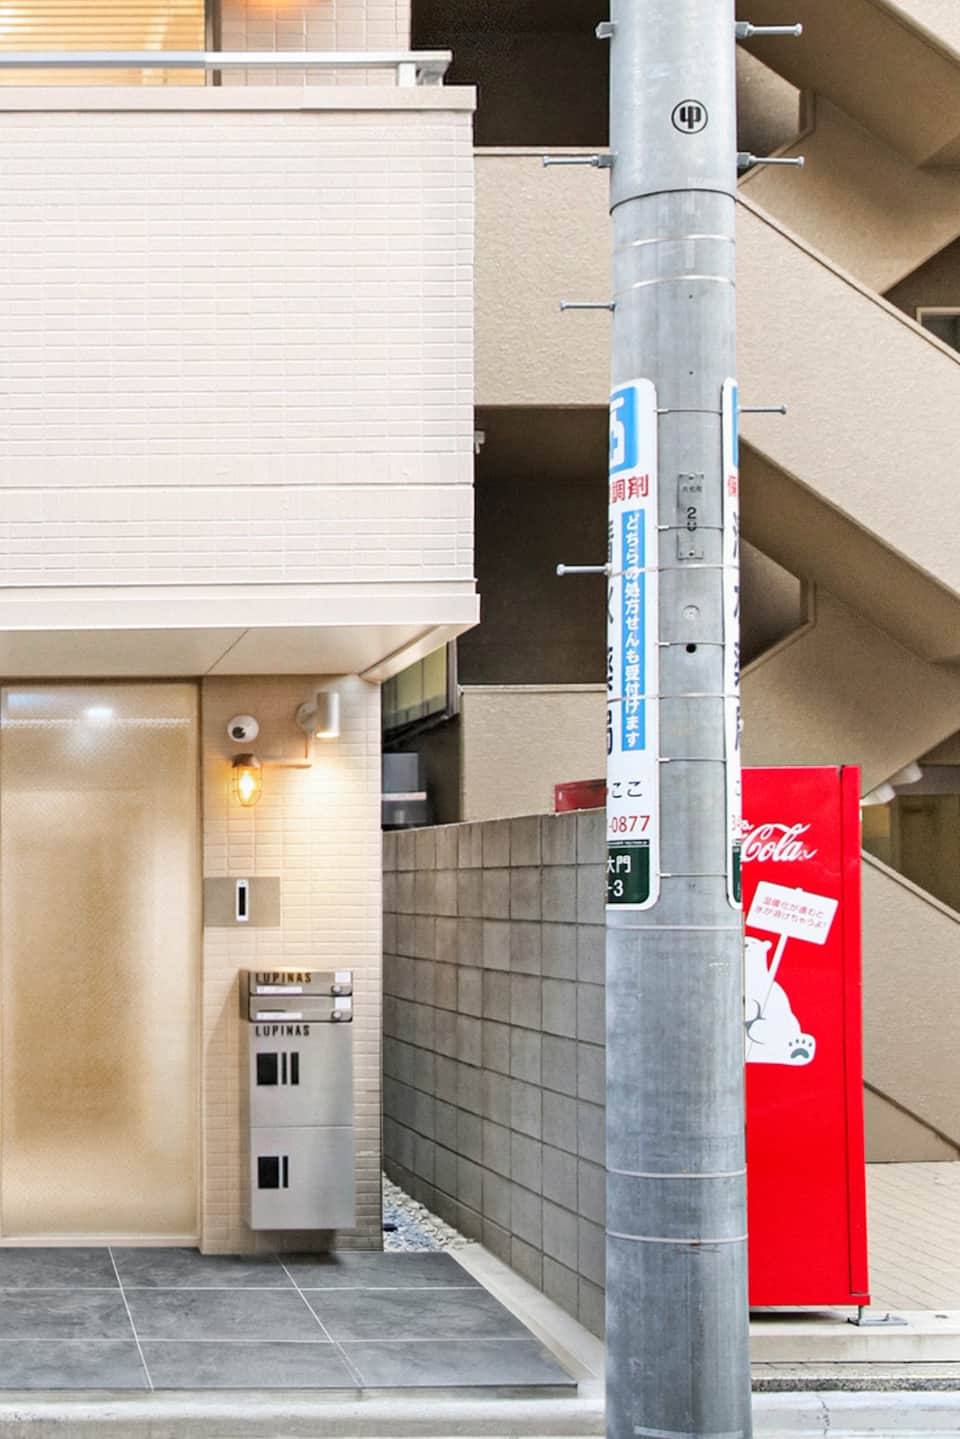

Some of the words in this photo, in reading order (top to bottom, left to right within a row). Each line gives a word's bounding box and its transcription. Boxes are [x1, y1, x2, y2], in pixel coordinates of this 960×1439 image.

[611, 474, 649, 503] 調剤
[612, 780, 643, 799] ここ
[255, 972, 312, 984] LUPINAS
[255, 1024, 311, 1037] LUPINAS
